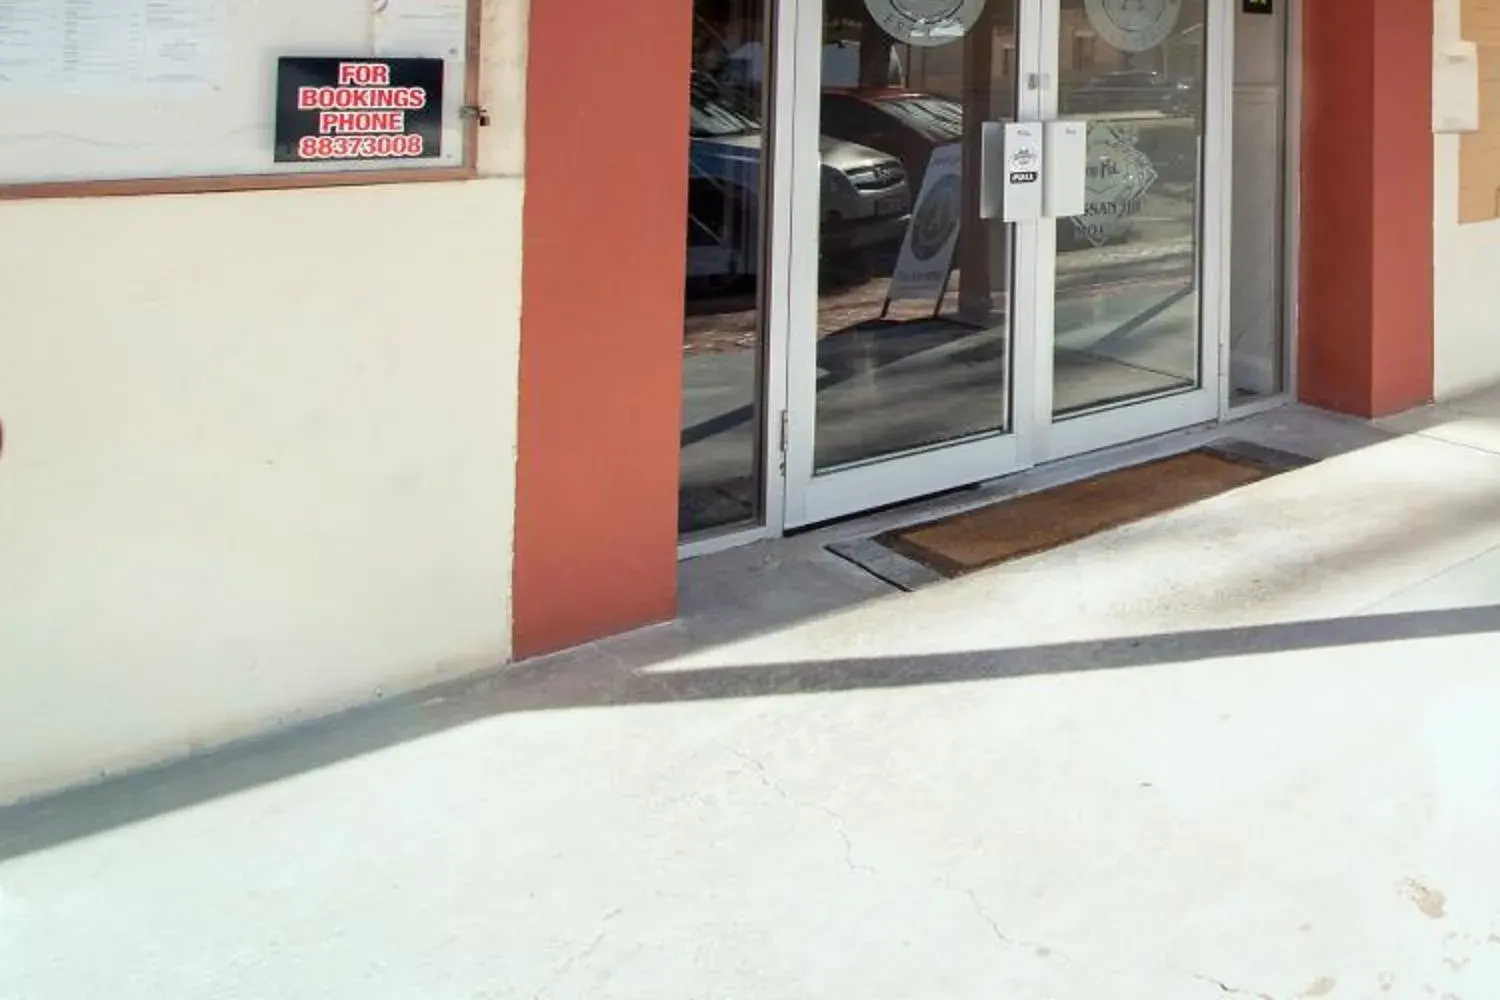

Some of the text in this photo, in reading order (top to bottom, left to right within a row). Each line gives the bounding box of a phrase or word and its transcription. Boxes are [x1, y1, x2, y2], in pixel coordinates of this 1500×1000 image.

[339, 63, 390, 85] FOR
[298, 86, 426, 109] BOOKINGS
[320, 111, 404, 133] PHONE
[298, 134, 423, 158] 88373008
